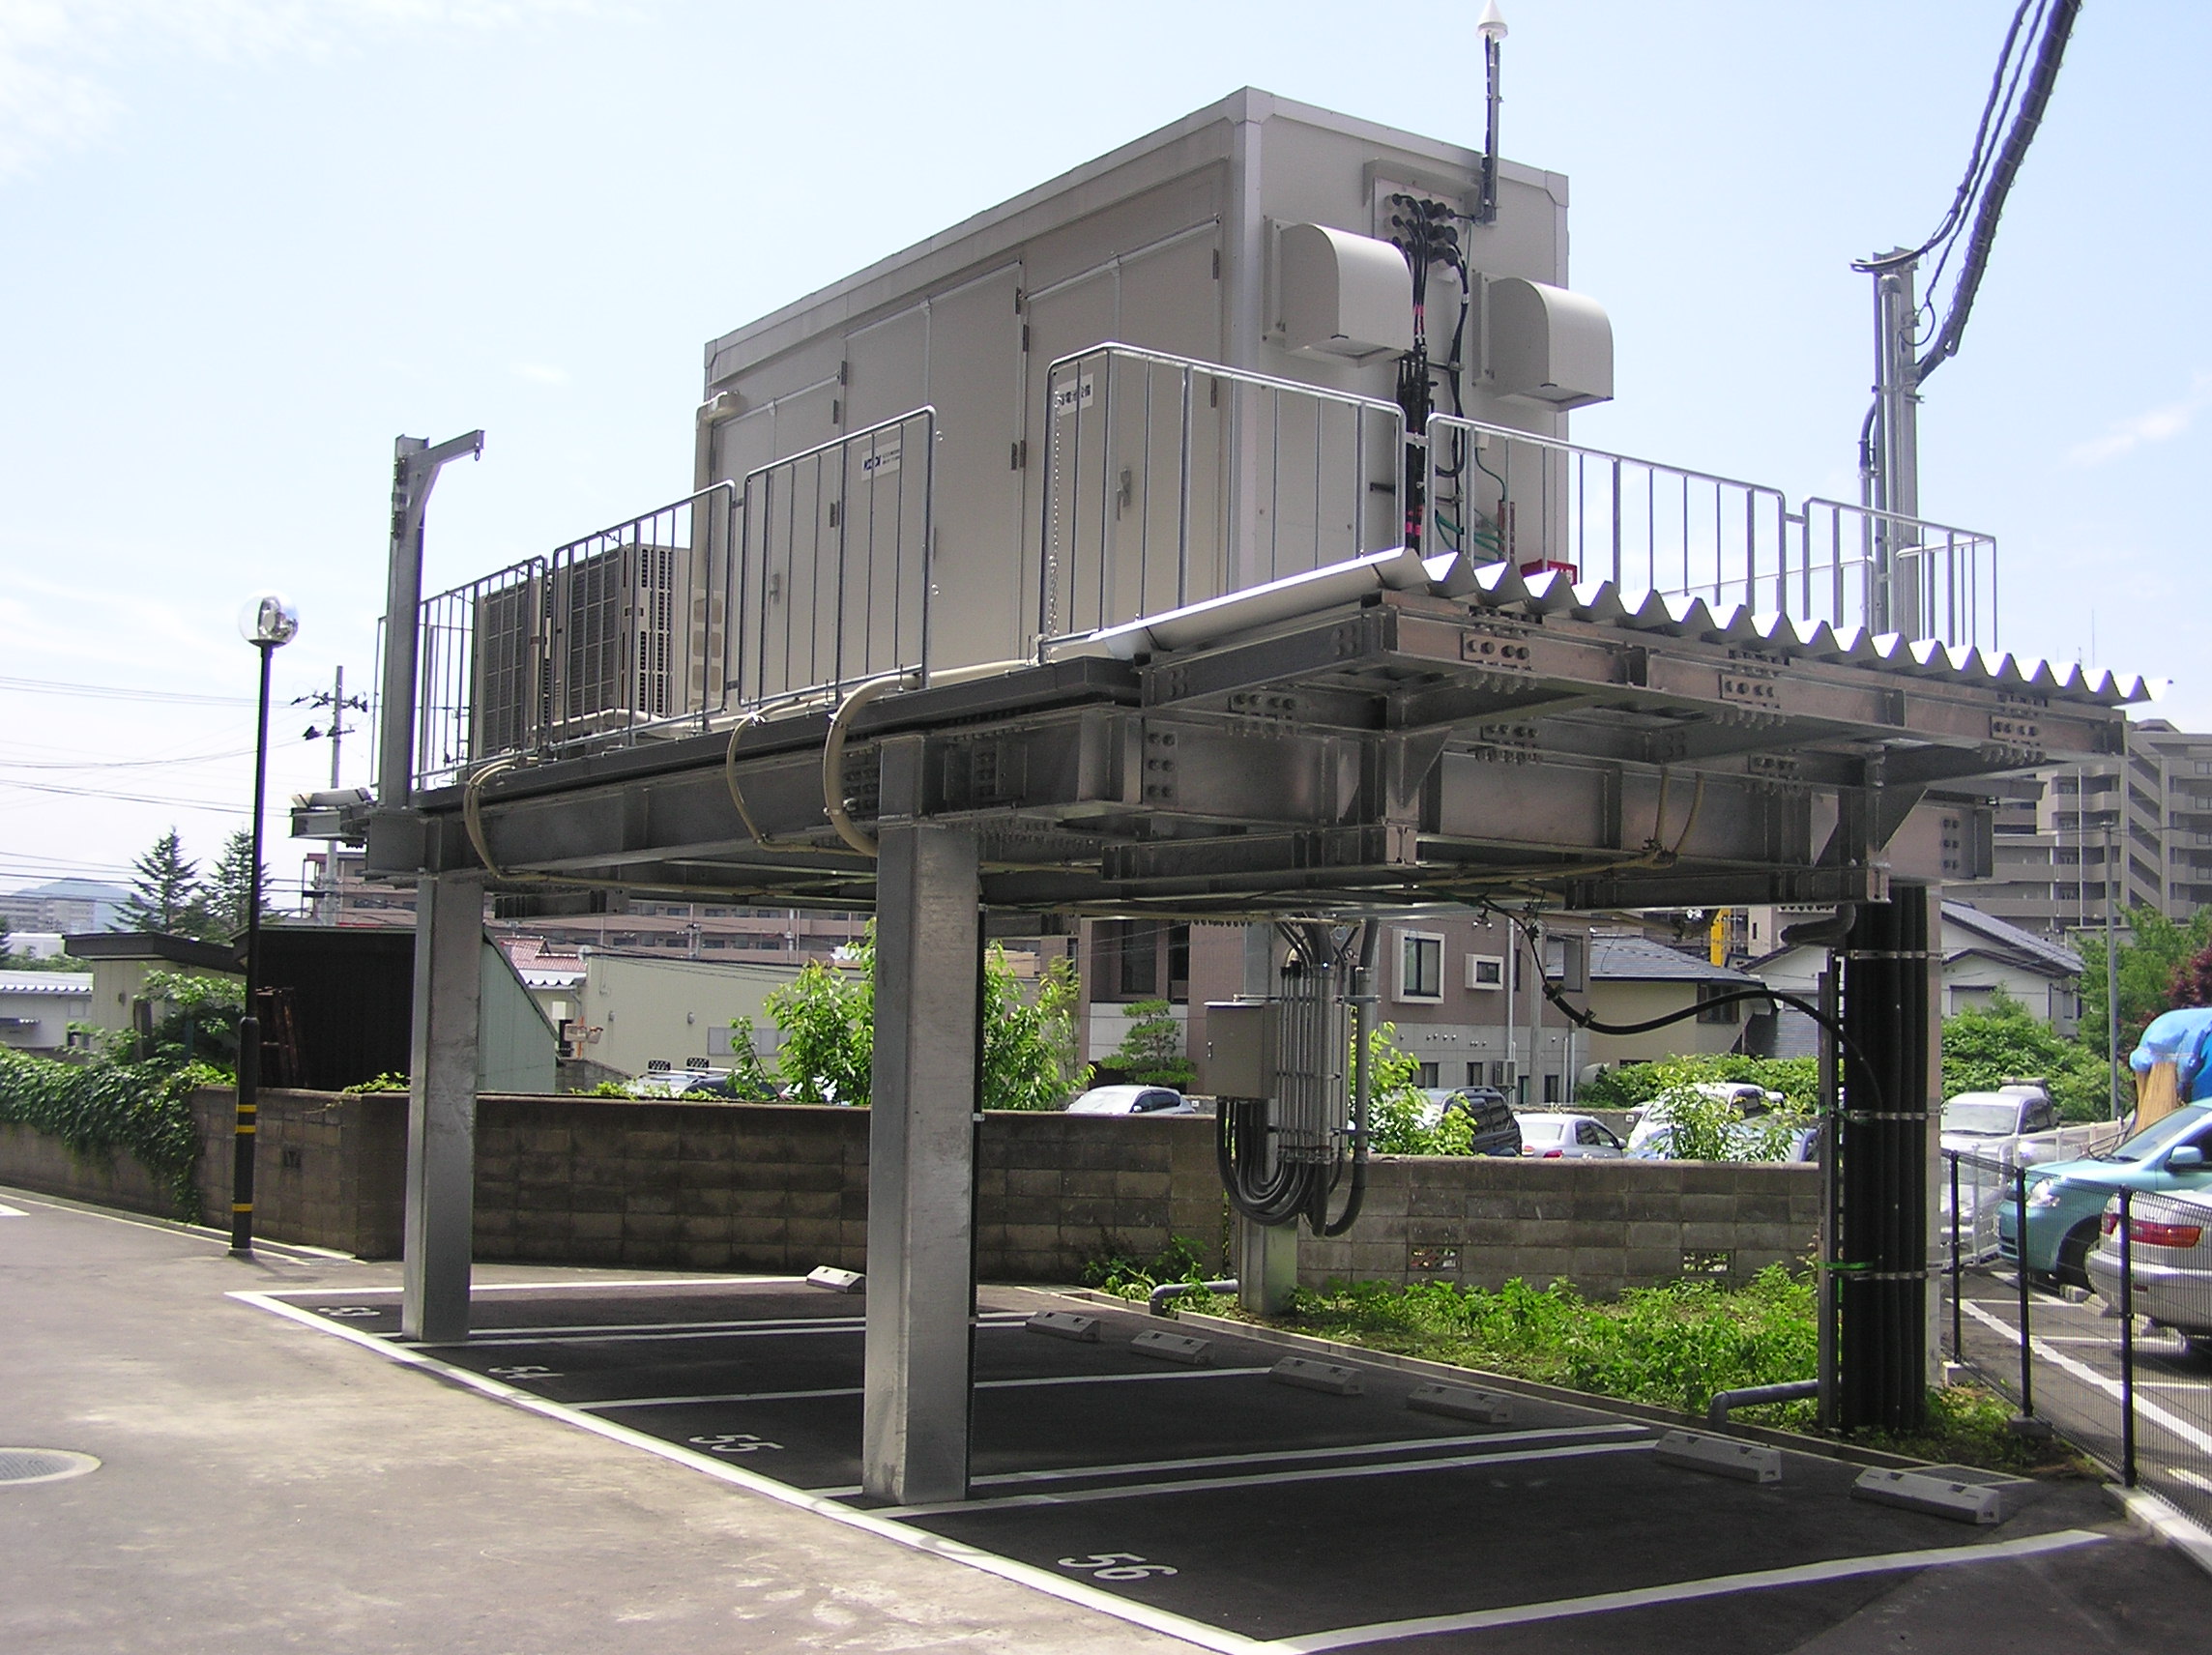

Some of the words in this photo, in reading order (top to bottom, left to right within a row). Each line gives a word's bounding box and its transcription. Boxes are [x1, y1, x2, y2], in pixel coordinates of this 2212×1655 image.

[488, 1365, 565, 1379] 54
[688, 1434, 784, 1452] 55
[1058, 1553, 1179, 1581] 56
